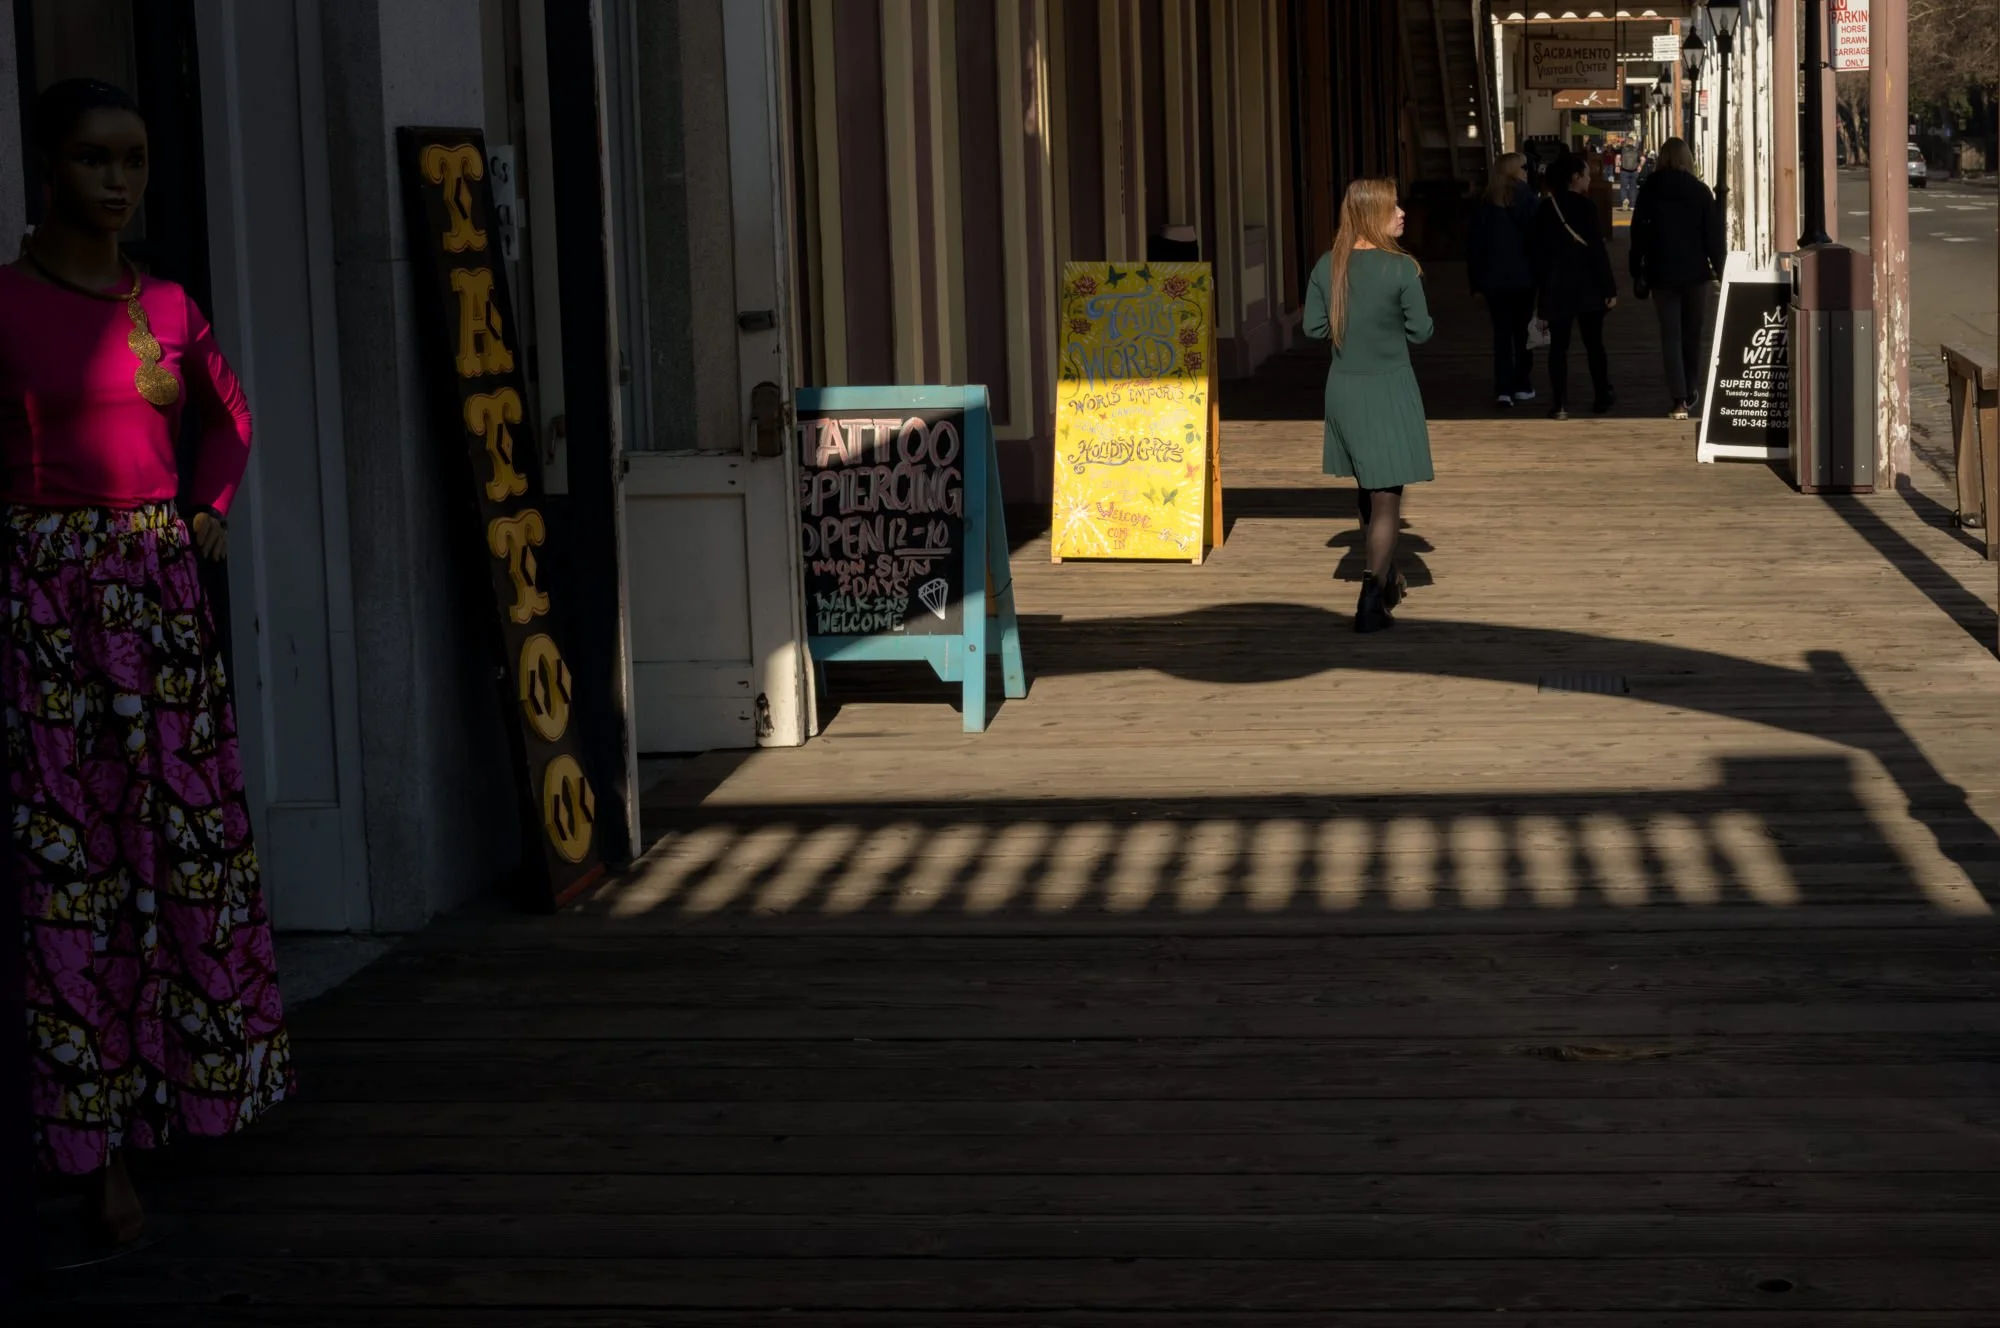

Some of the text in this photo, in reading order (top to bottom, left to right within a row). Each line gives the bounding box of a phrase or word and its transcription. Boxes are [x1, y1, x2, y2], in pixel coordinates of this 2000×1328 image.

[1831, 10, 1868, 24] PARKIN
[1841, 25, 1867, 33] HORSE
[1841, 36, 1868, 45] DRAWN
[1533, 42, 1611, 64] SACRAMENTO
[1576, 61, 1607, 77] CENTER
[1845, 58, 1865, 67] ONLY
[1087, 285, 1185, 340] FAIRY
[1068, 337, 1176, 391] WORLD
[1742, 370, 1788, 380] CLOTHIN
[1719, 379, 1751, 389] SUPER
[1754, 380, 1774, 390] BOX
[1069, 391, 1121, 415] WORLD
[1128, 381, 1184, 405] IMPORTS
[1725, 389, 1749, 397] Tuesday
[1739, 399, 1759, 407] 1008
[1761, 400, 1778, 408] 2nd
[1720, 407, 1768, 417] Sacramento
[1769, 409, 1782, 417] CA
[797, 416, 960, 467] TATTOO
[1068, 436, 1184, 474] HOLIDAY GIFTS
[419, 141, 598, 865] TATTOO
[1096, 502, 1152, 529] WELCOME
[816, 611, 905, 635] WELCOME
